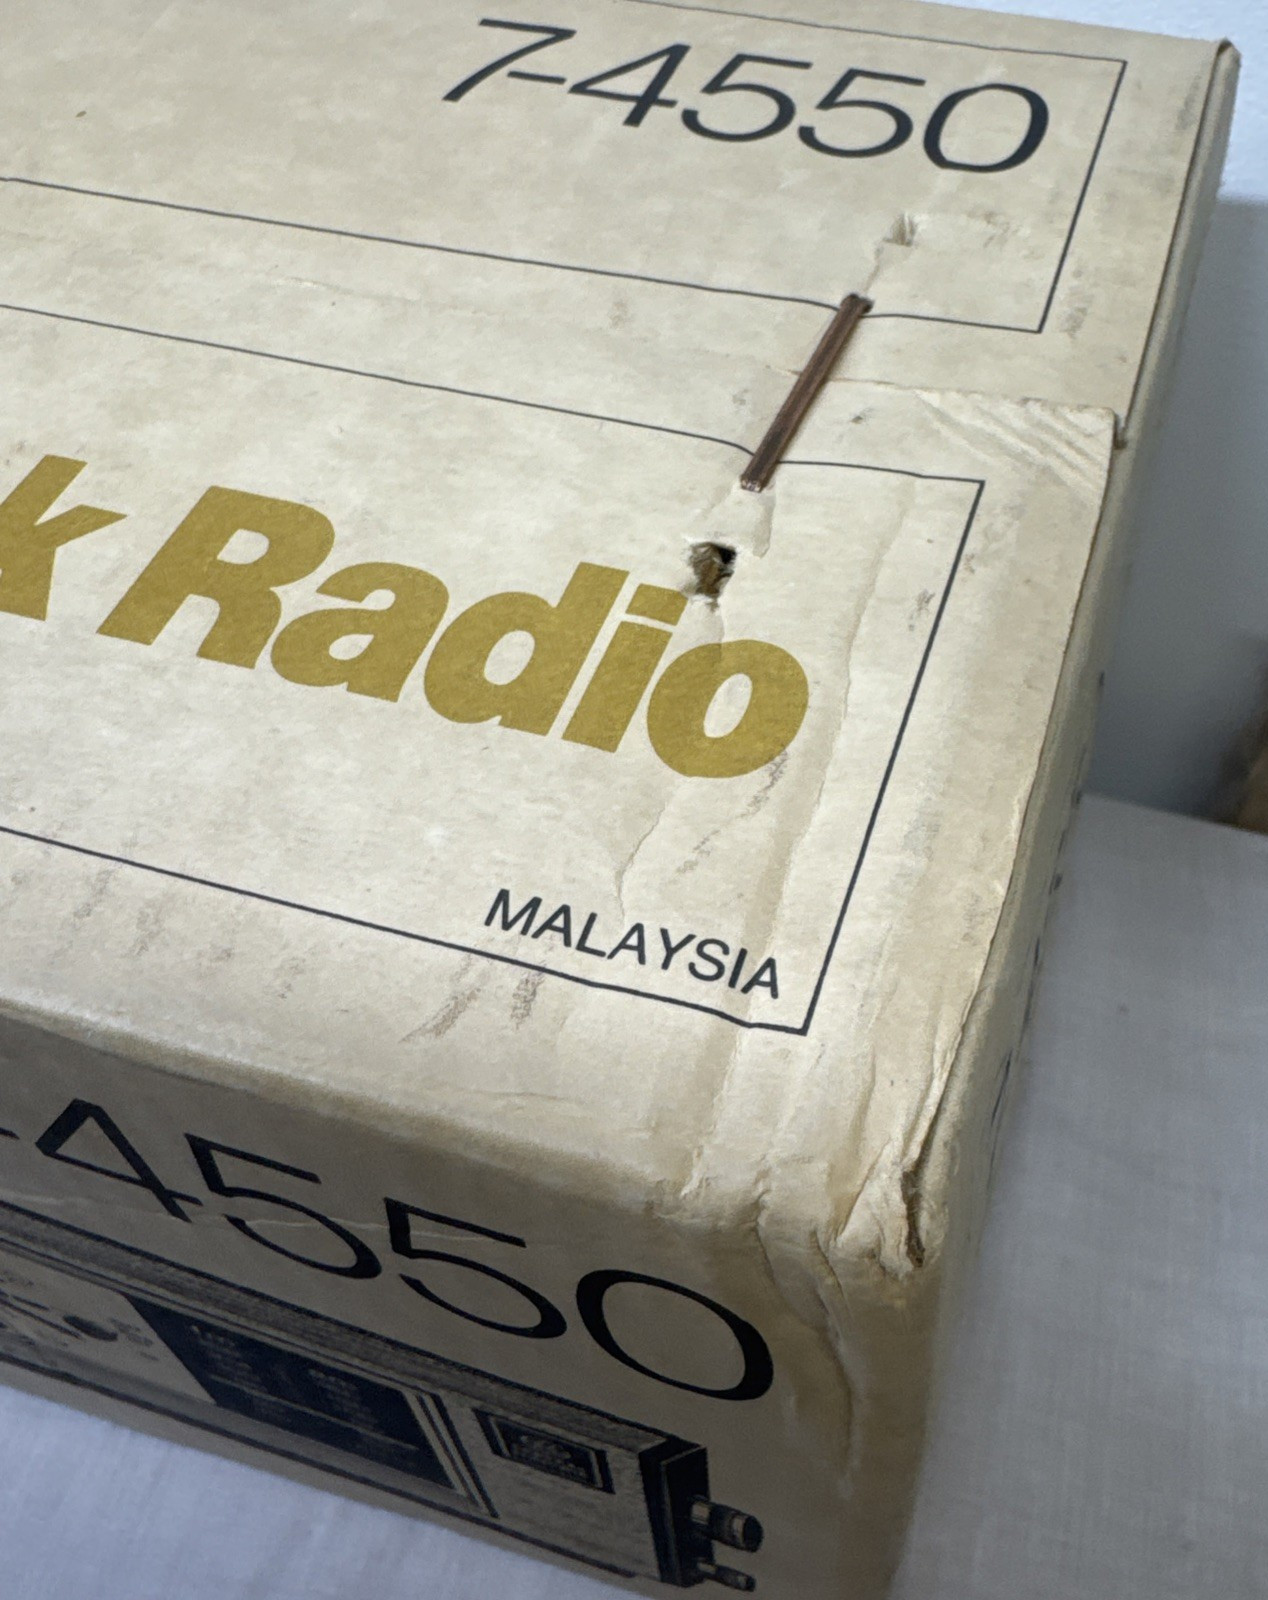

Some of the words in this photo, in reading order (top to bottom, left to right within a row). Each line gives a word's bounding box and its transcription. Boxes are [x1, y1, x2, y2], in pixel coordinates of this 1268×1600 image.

[442, 18, 1049, 174] 7-4550
[97, 485, 809, 778] Radio
[484, 888, 779, 1000] MALAYSIA
[0, 1098, 774, 1401] 4550
